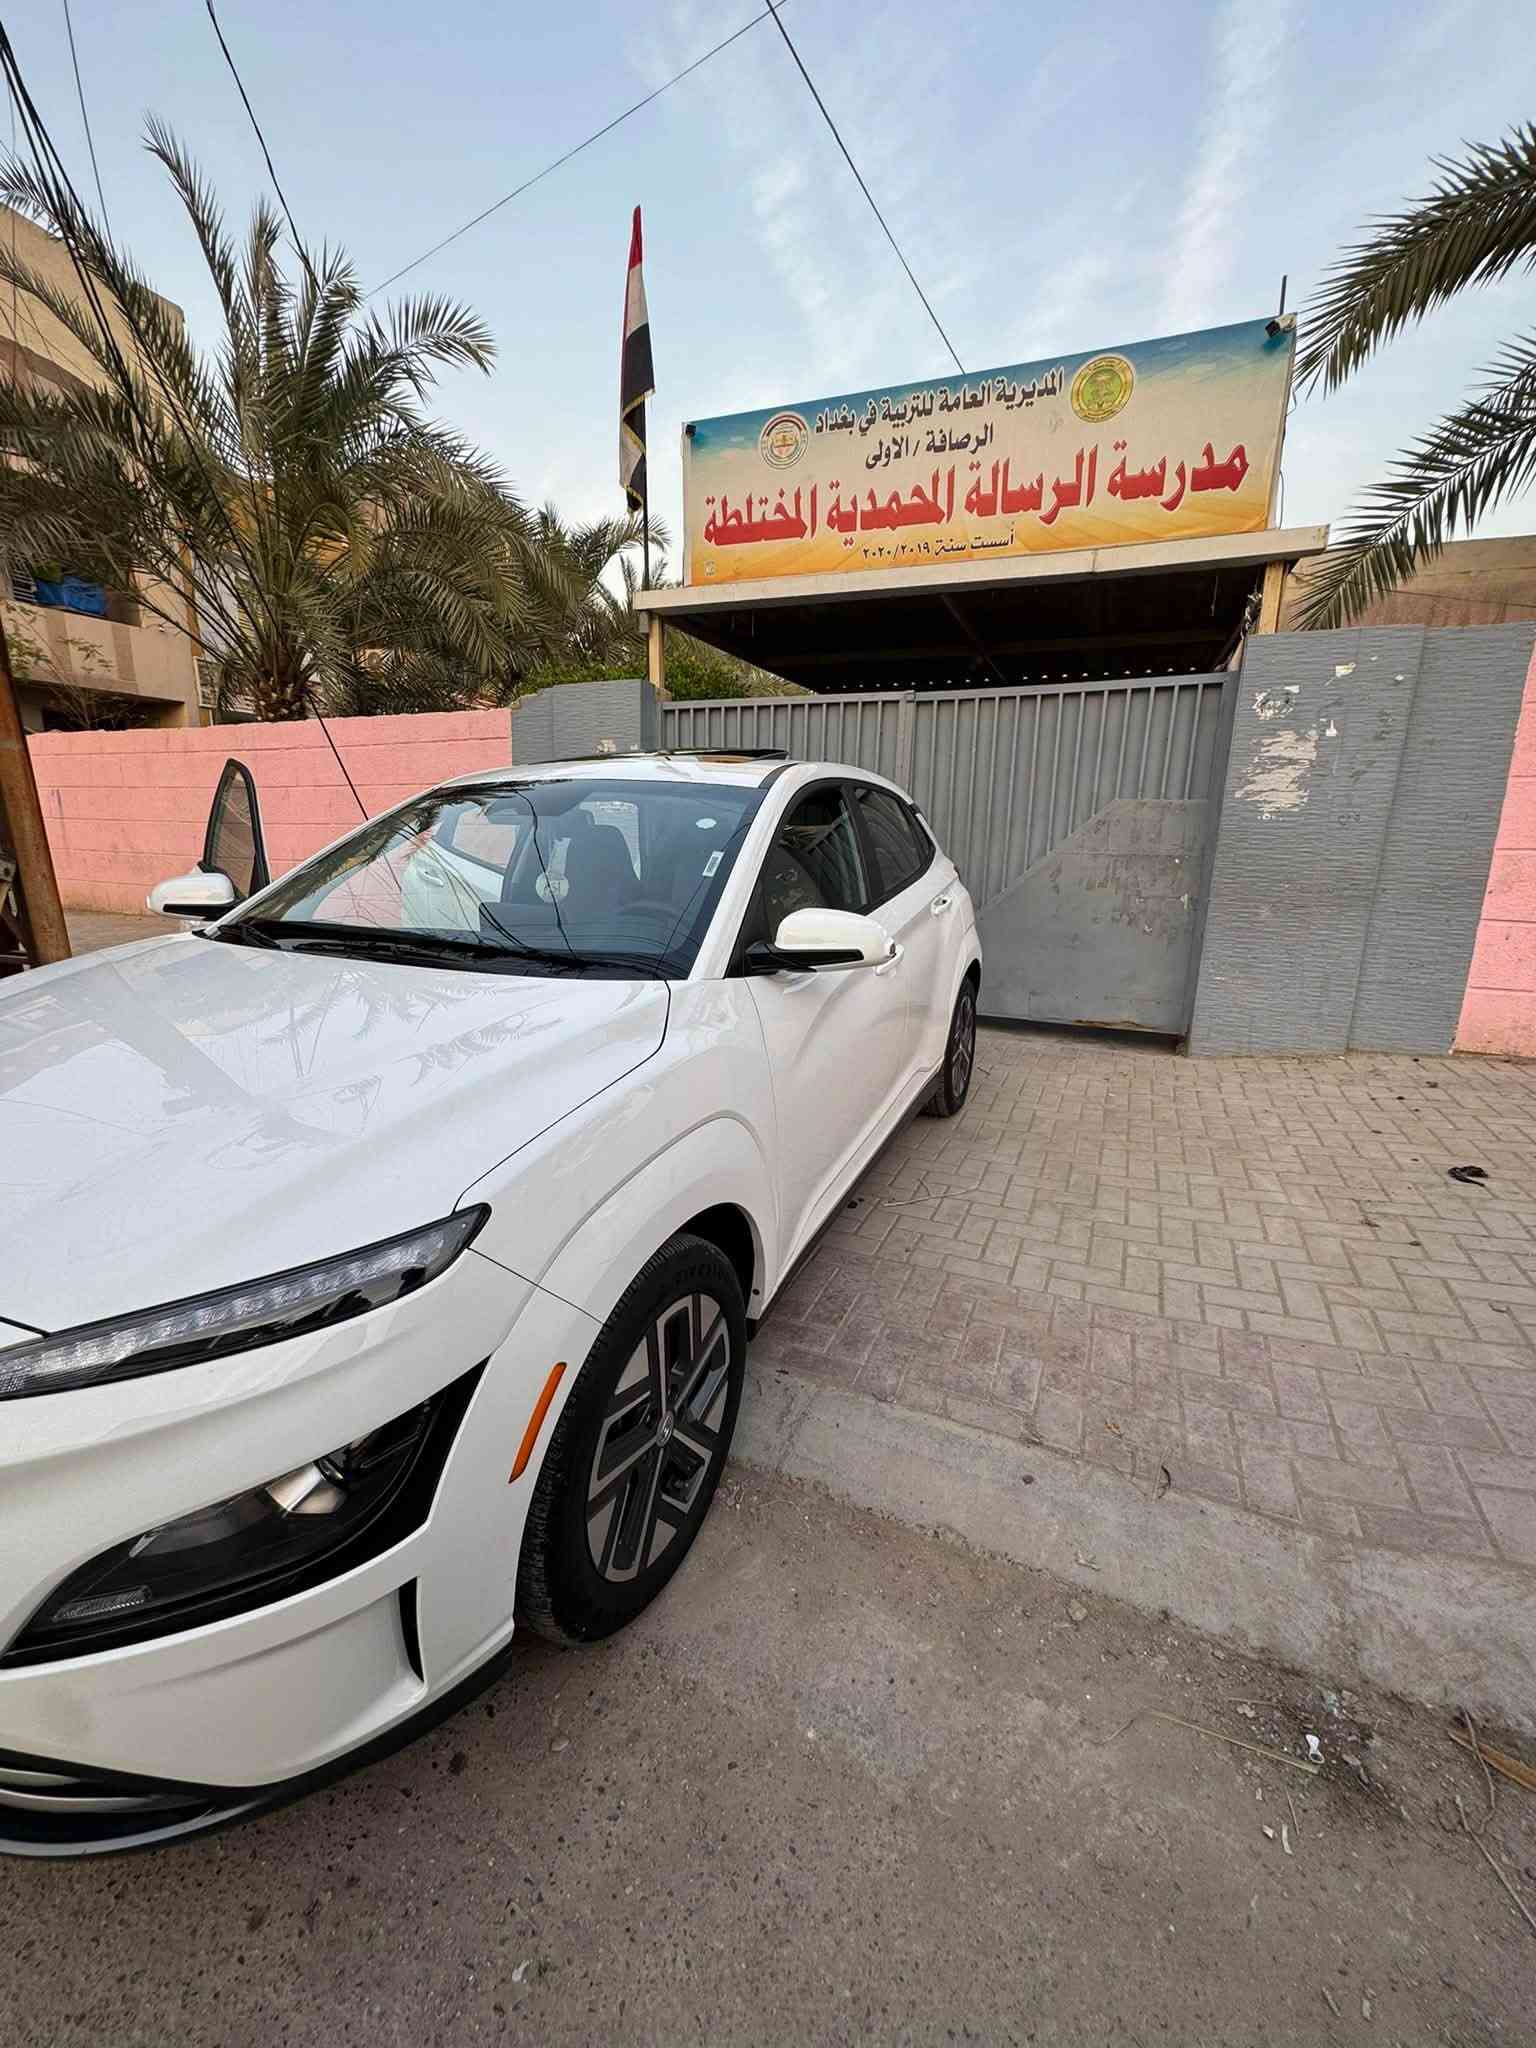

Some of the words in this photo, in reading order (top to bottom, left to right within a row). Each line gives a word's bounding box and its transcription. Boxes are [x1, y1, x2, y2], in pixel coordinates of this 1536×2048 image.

[938, 382, 991, 413] العامة
[997, 368, 1064, 410] المديرية
[815, 405, 855, 434] بغداد
[858, 400, 877, 436] في
[881, 393, 934, 429] للتربية
[925, 423, 994, 454] الرصافة
[964, 443, 1099, 525] الرسالة
[1107, 440, 1250, 512] مدرسة
[704, 482, 818, 546] المختلطة
[826, 464, 956, 547] المحمدية
[934, 539, 967, 556] سنة
[970, 528, 1015, 549] أسست
